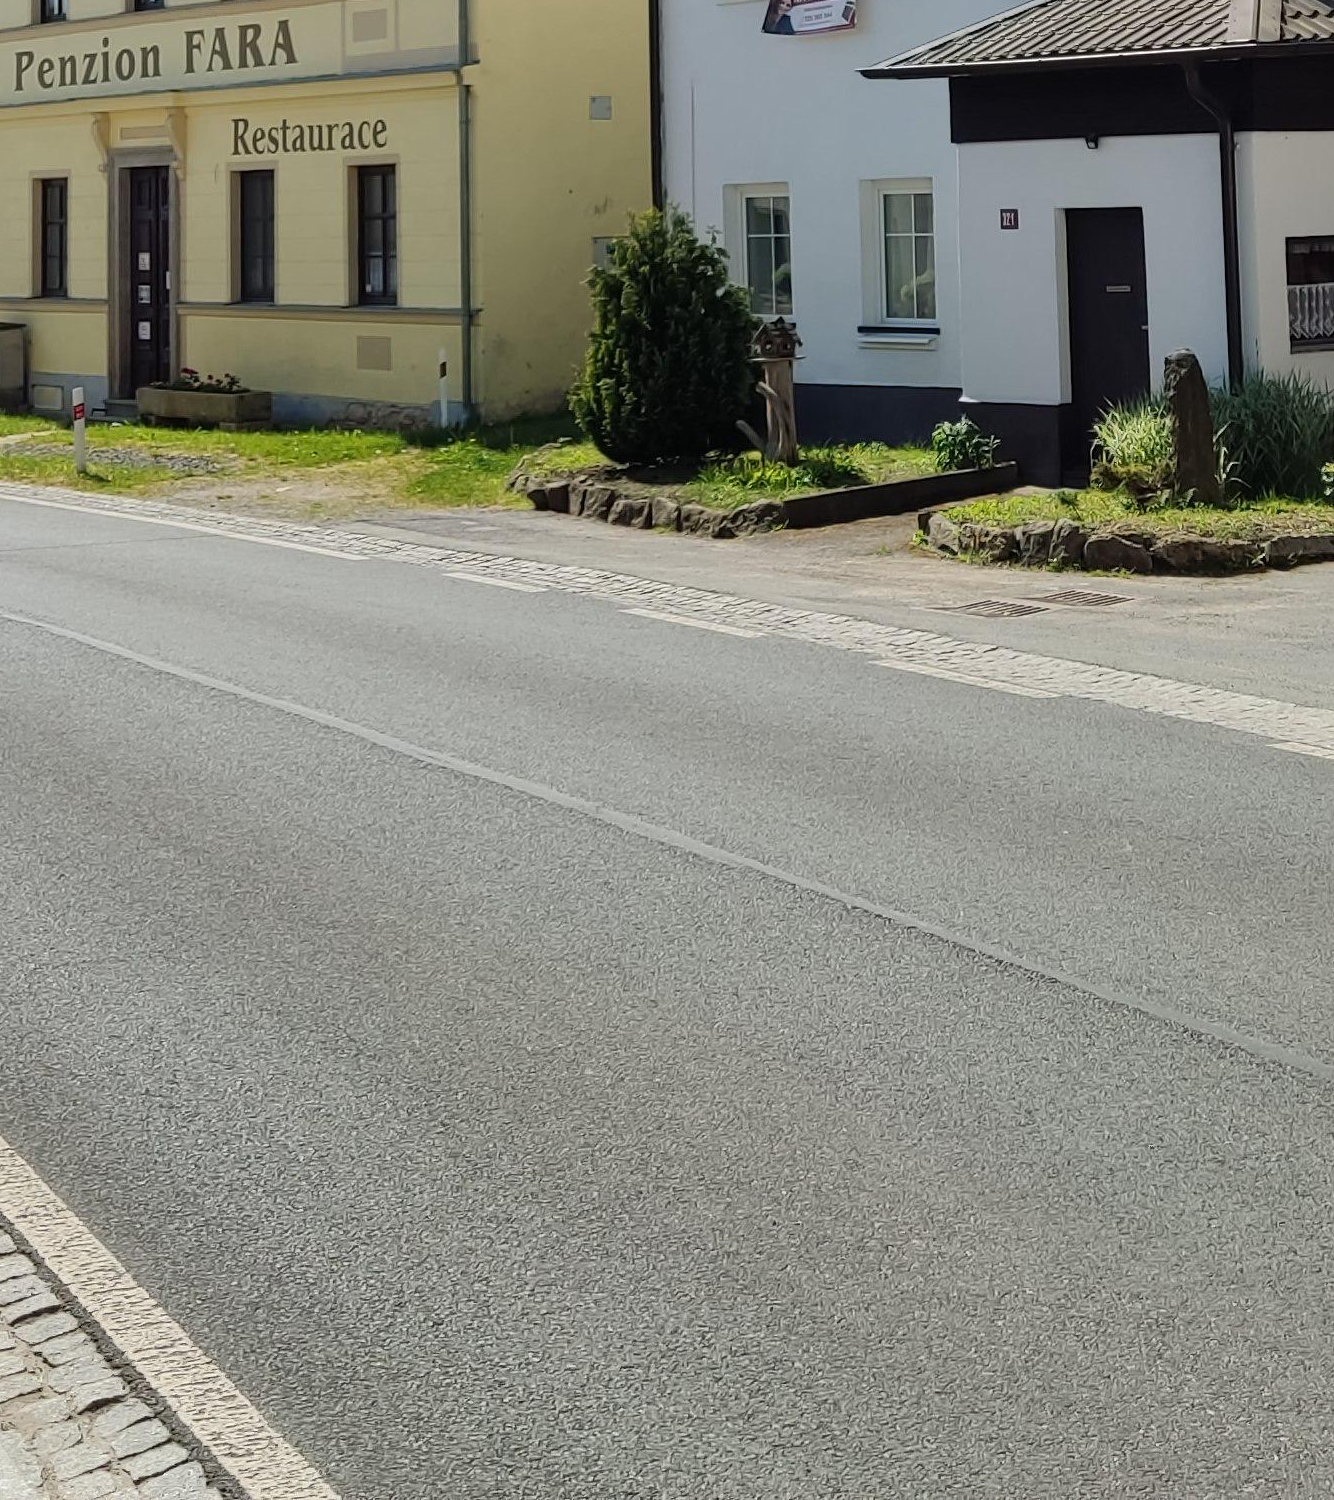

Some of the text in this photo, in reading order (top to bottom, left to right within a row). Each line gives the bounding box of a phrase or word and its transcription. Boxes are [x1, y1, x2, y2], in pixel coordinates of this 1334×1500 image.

[13, 18, 299, 92] Penzion FARA
[230, 117, 389, 156] Restaurace
